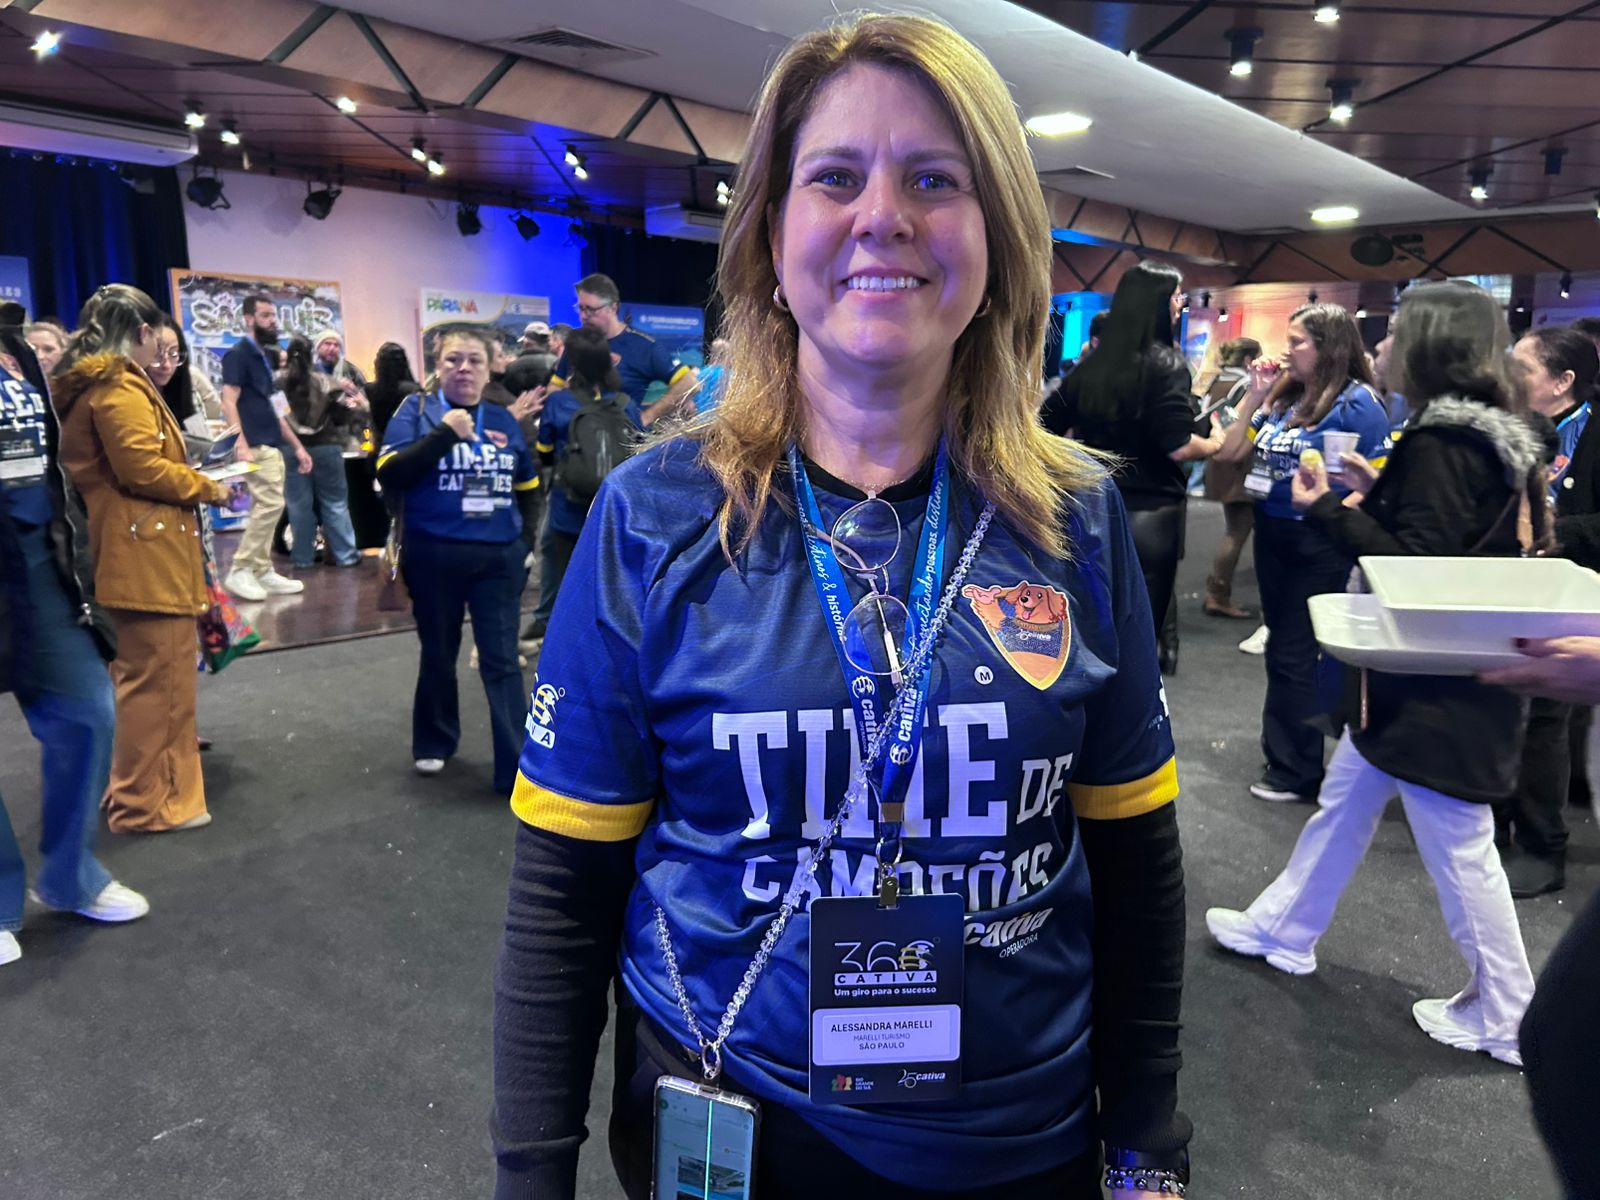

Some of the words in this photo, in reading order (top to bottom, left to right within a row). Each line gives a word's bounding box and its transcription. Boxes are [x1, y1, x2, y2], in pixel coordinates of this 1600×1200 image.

[822, 582, 837, 592] &
[979, 671, 991, 681] M
[898, 688, 918, 742] cativa
[1016, 752, 1074, 825] DE
[963, 907, 1054, 948] cativa
[999, 932, 1039, 959] OPERADORA
[837, 972, 934, 984] CATIVA
[834, 988, 850, 996] Um
[852, 988, 870, 997] giro
[872, 987, 892, 996] para
[901, 986, 937, 994] sucesso
[830, 1021, 892, 1033] ALESSANDRA
[893, 1020, 933, 1030] MARELLI
[859, 1042, 877, 1050] SÃO
[878, 1041, 905, 1049] PAULO
[916, 1071, 946, 1081] cativa
